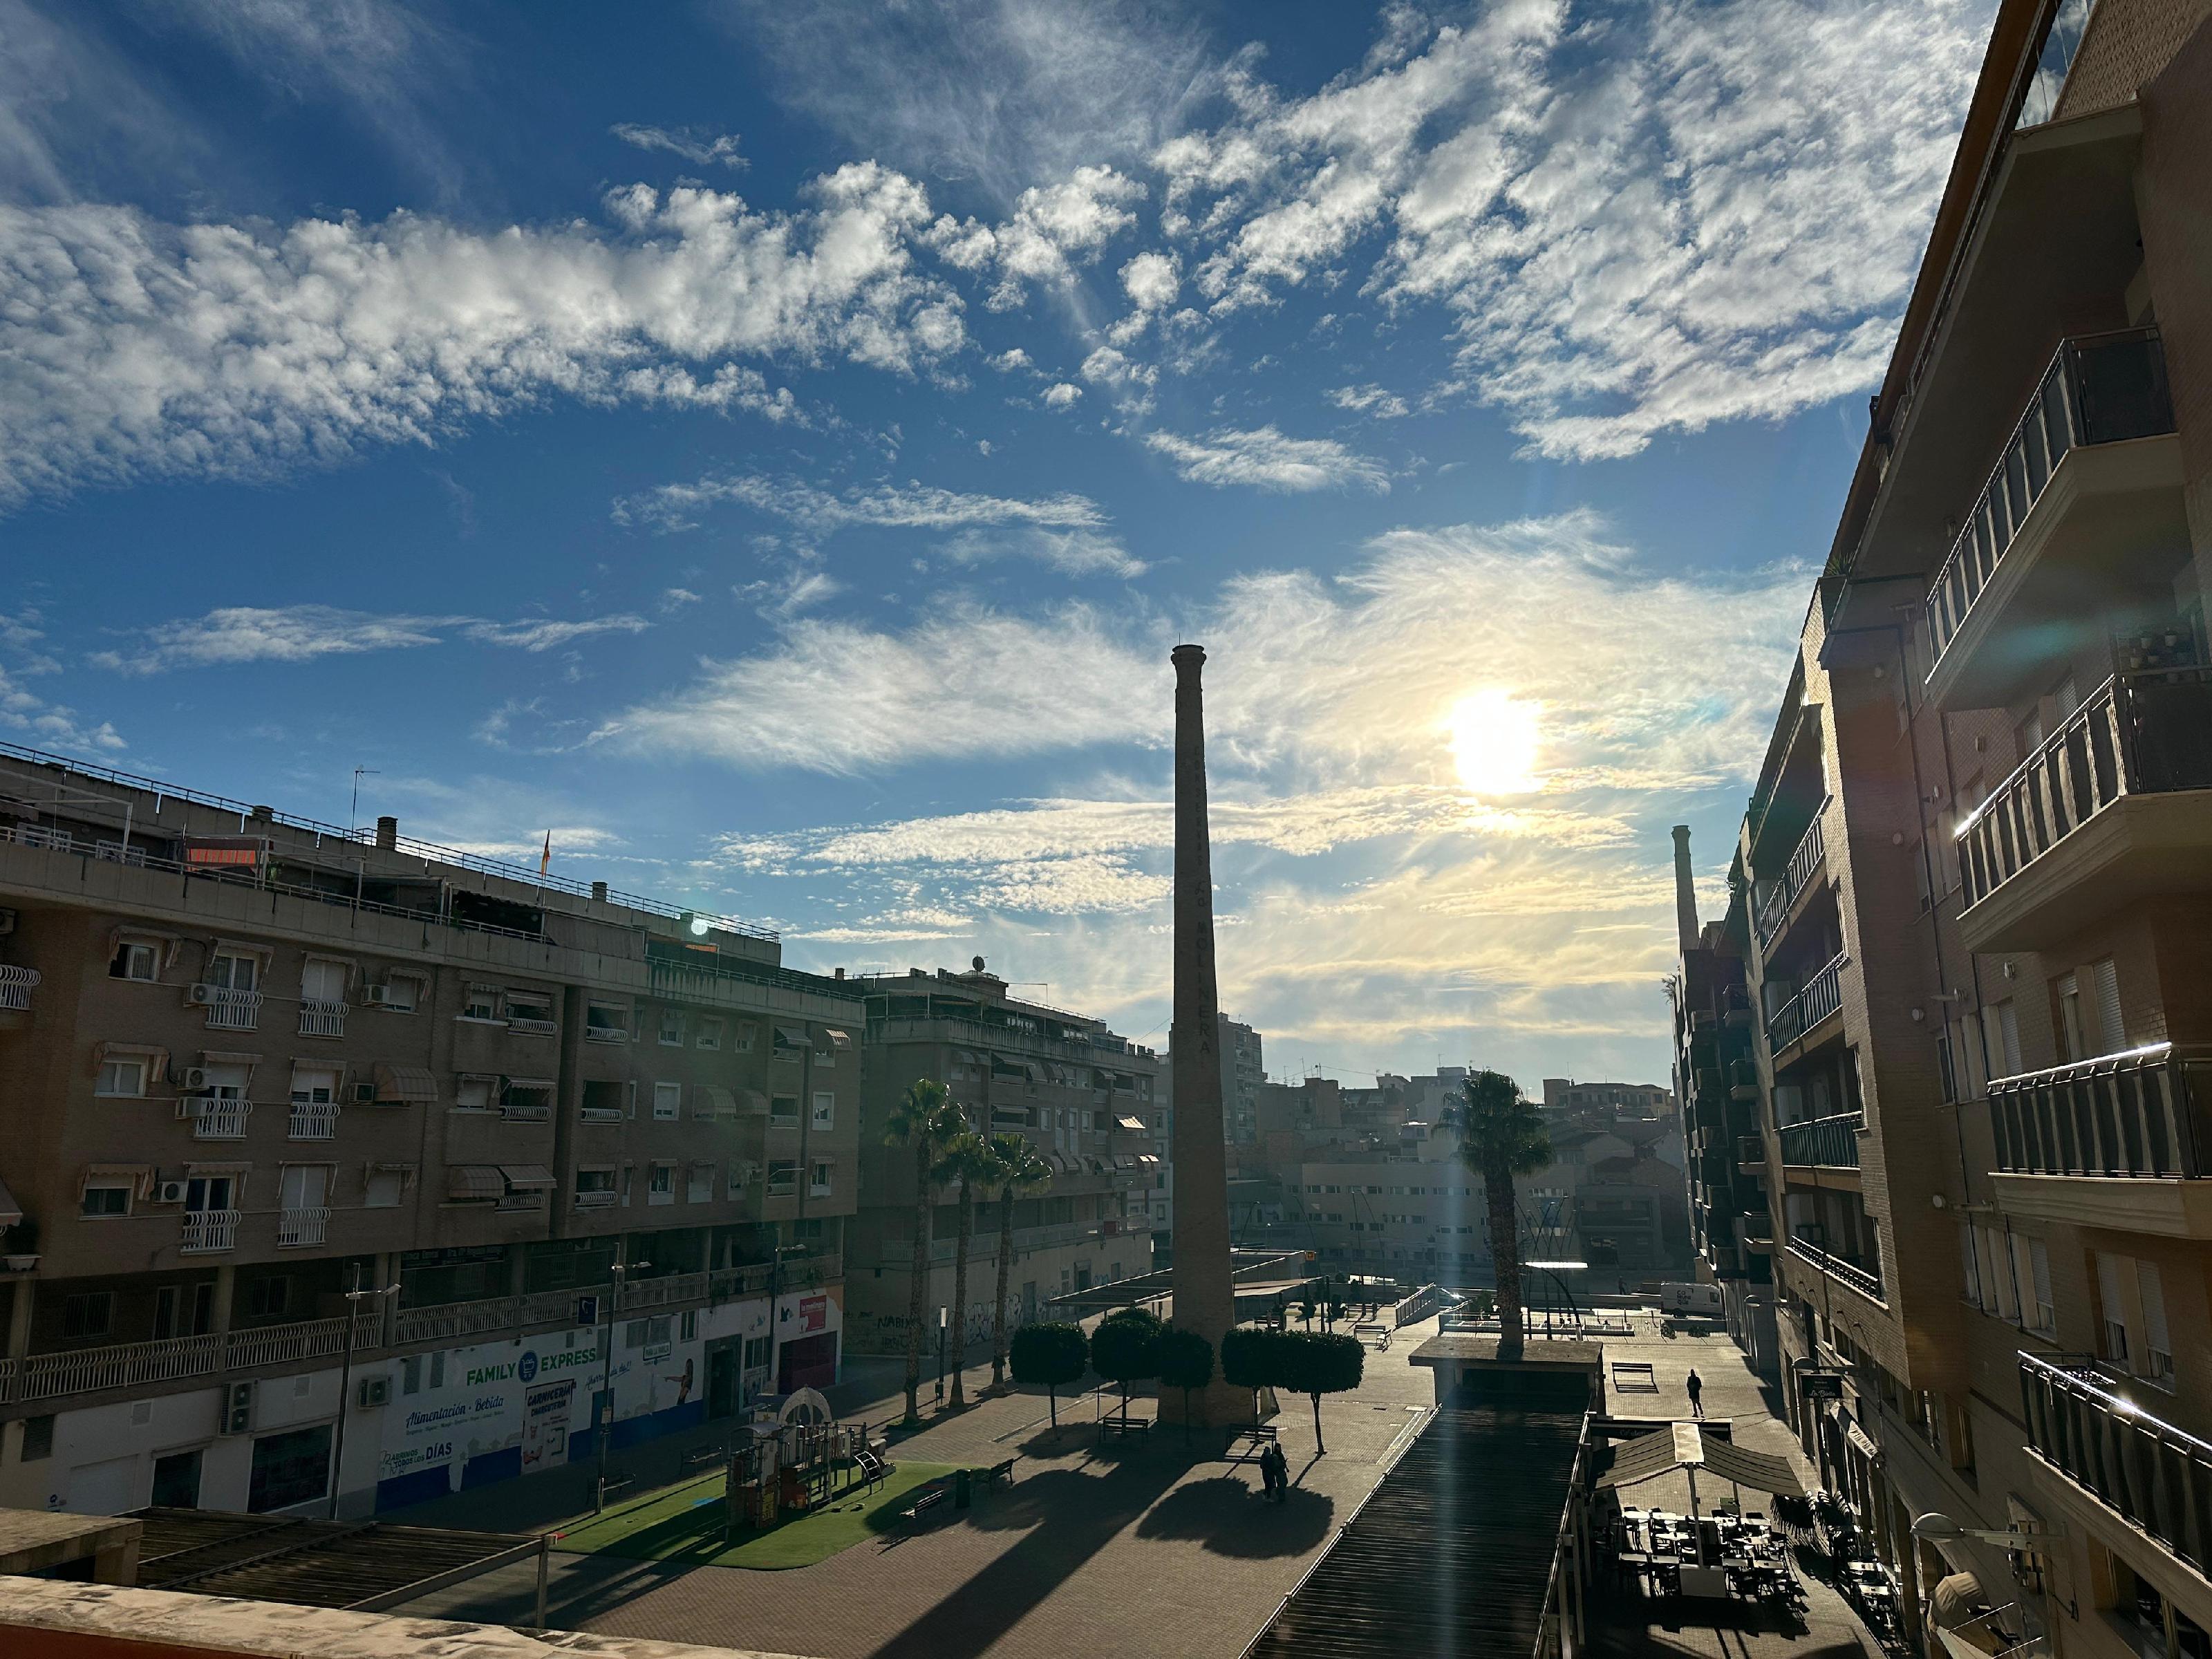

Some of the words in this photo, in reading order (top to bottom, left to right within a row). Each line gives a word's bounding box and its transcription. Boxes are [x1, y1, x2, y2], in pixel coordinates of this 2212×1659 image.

[1197, 921, 1210, 1053] MOLINERA
[467, 1362, 517, 1386] FAMILY
[541, 1348, 597, 1371] EXPRESS
[527, 1382, 570, 1407] CARNICERÍA
[406, 1400, 467, 1428] Alimentación
[475, 1396, 504, 1412] Bebida
[426, 1442, 452, 1460] DÍAS
